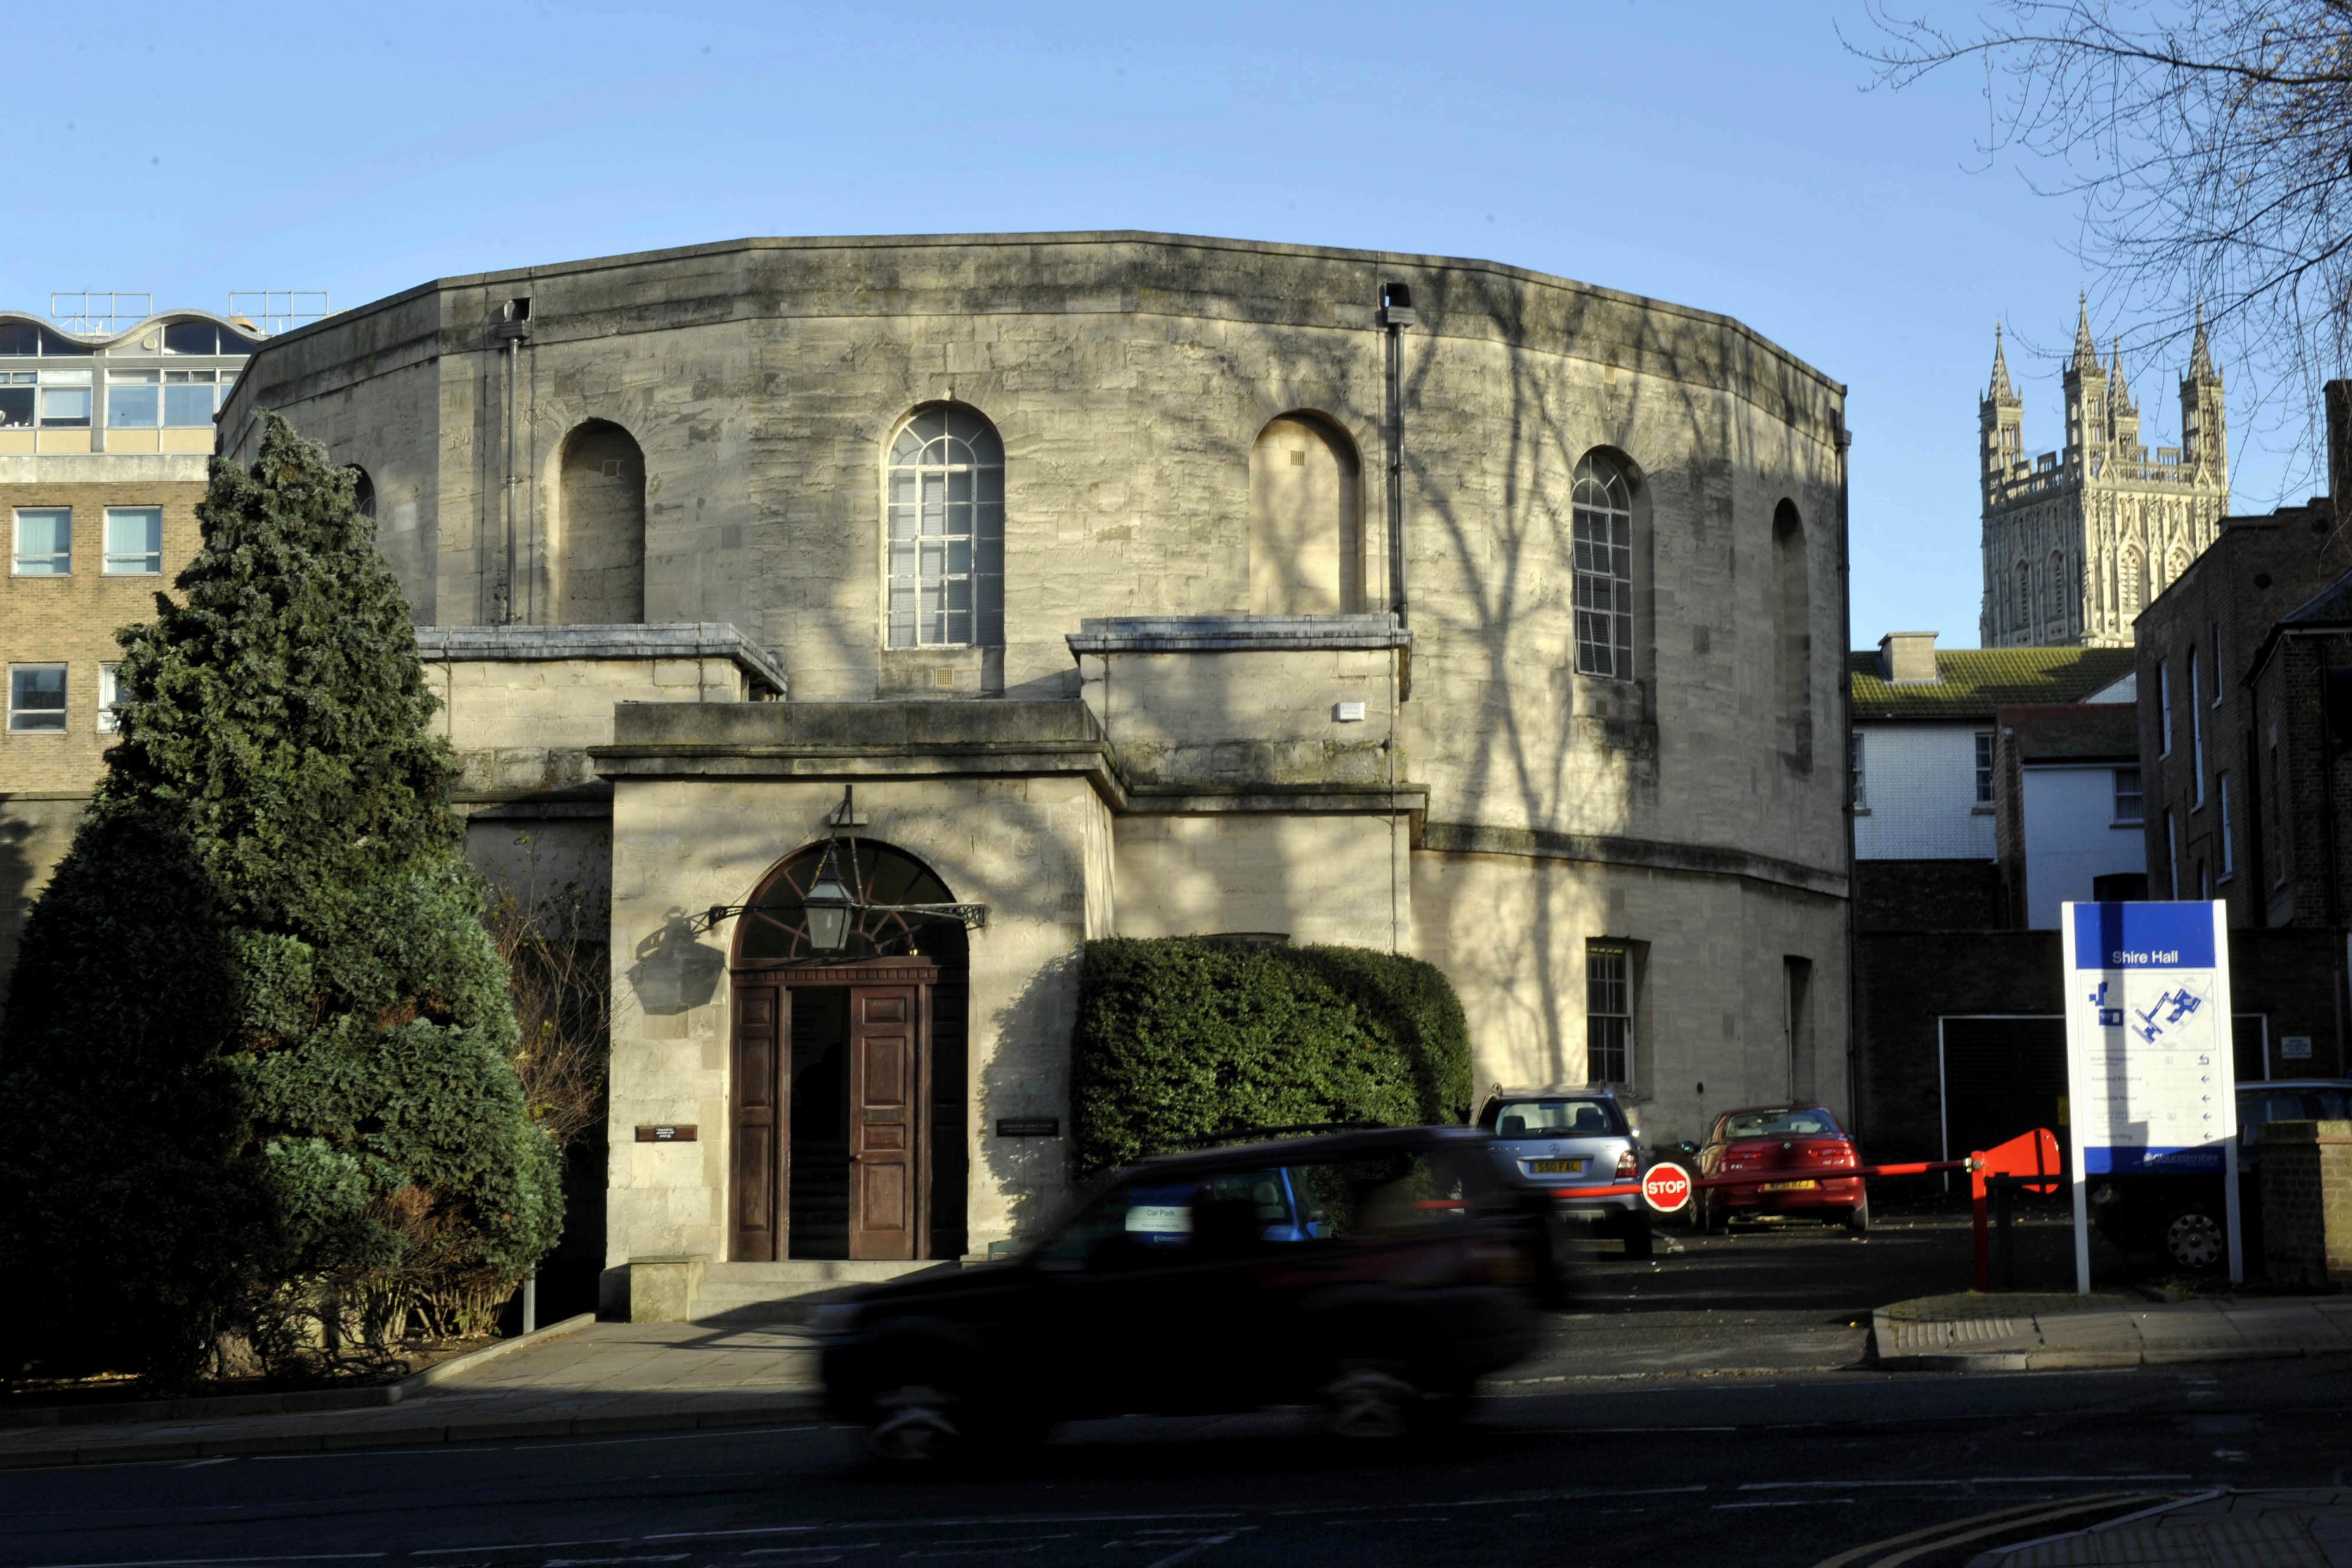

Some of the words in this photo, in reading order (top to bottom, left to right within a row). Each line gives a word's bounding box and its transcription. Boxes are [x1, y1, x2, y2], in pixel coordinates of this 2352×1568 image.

[2112, 950, 2148, 964] Shire
[2151, 950, 2178, 963] Hall
[1648, 1180, 1686, 1195] STOP
